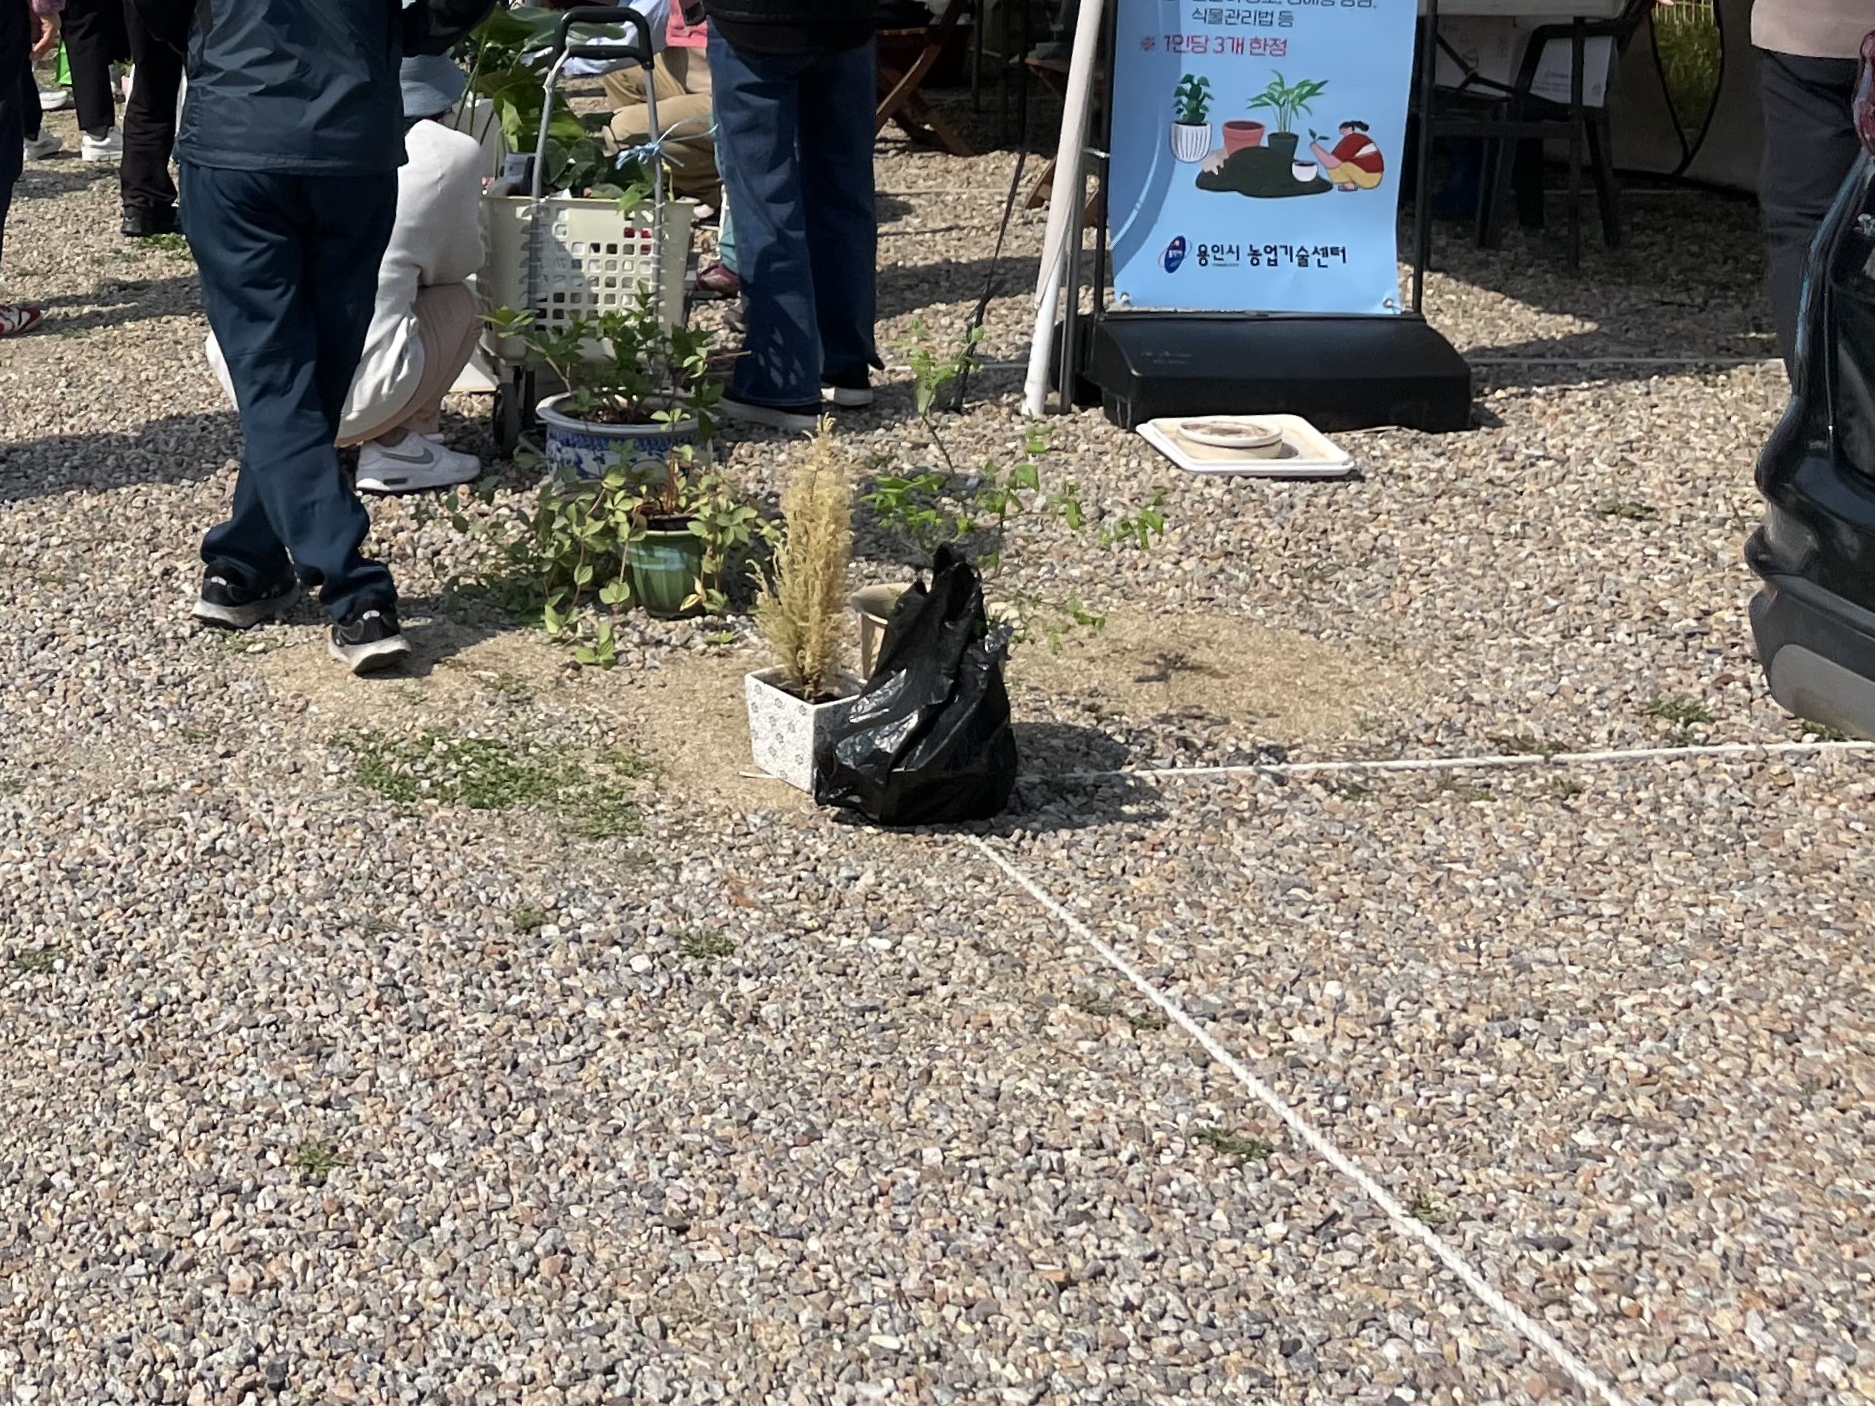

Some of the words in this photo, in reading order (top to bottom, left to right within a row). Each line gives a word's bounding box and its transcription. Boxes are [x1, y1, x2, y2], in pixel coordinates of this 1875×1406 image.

[1277, 10, 1295, 28] 등
[1163, 35, 1210, 54] 1인당
[1213, 36, 1245, 56] 3개
[1197, 243, 1241, 268] 용인시
[1246, 243, 1348, 270] 농업기술센터
